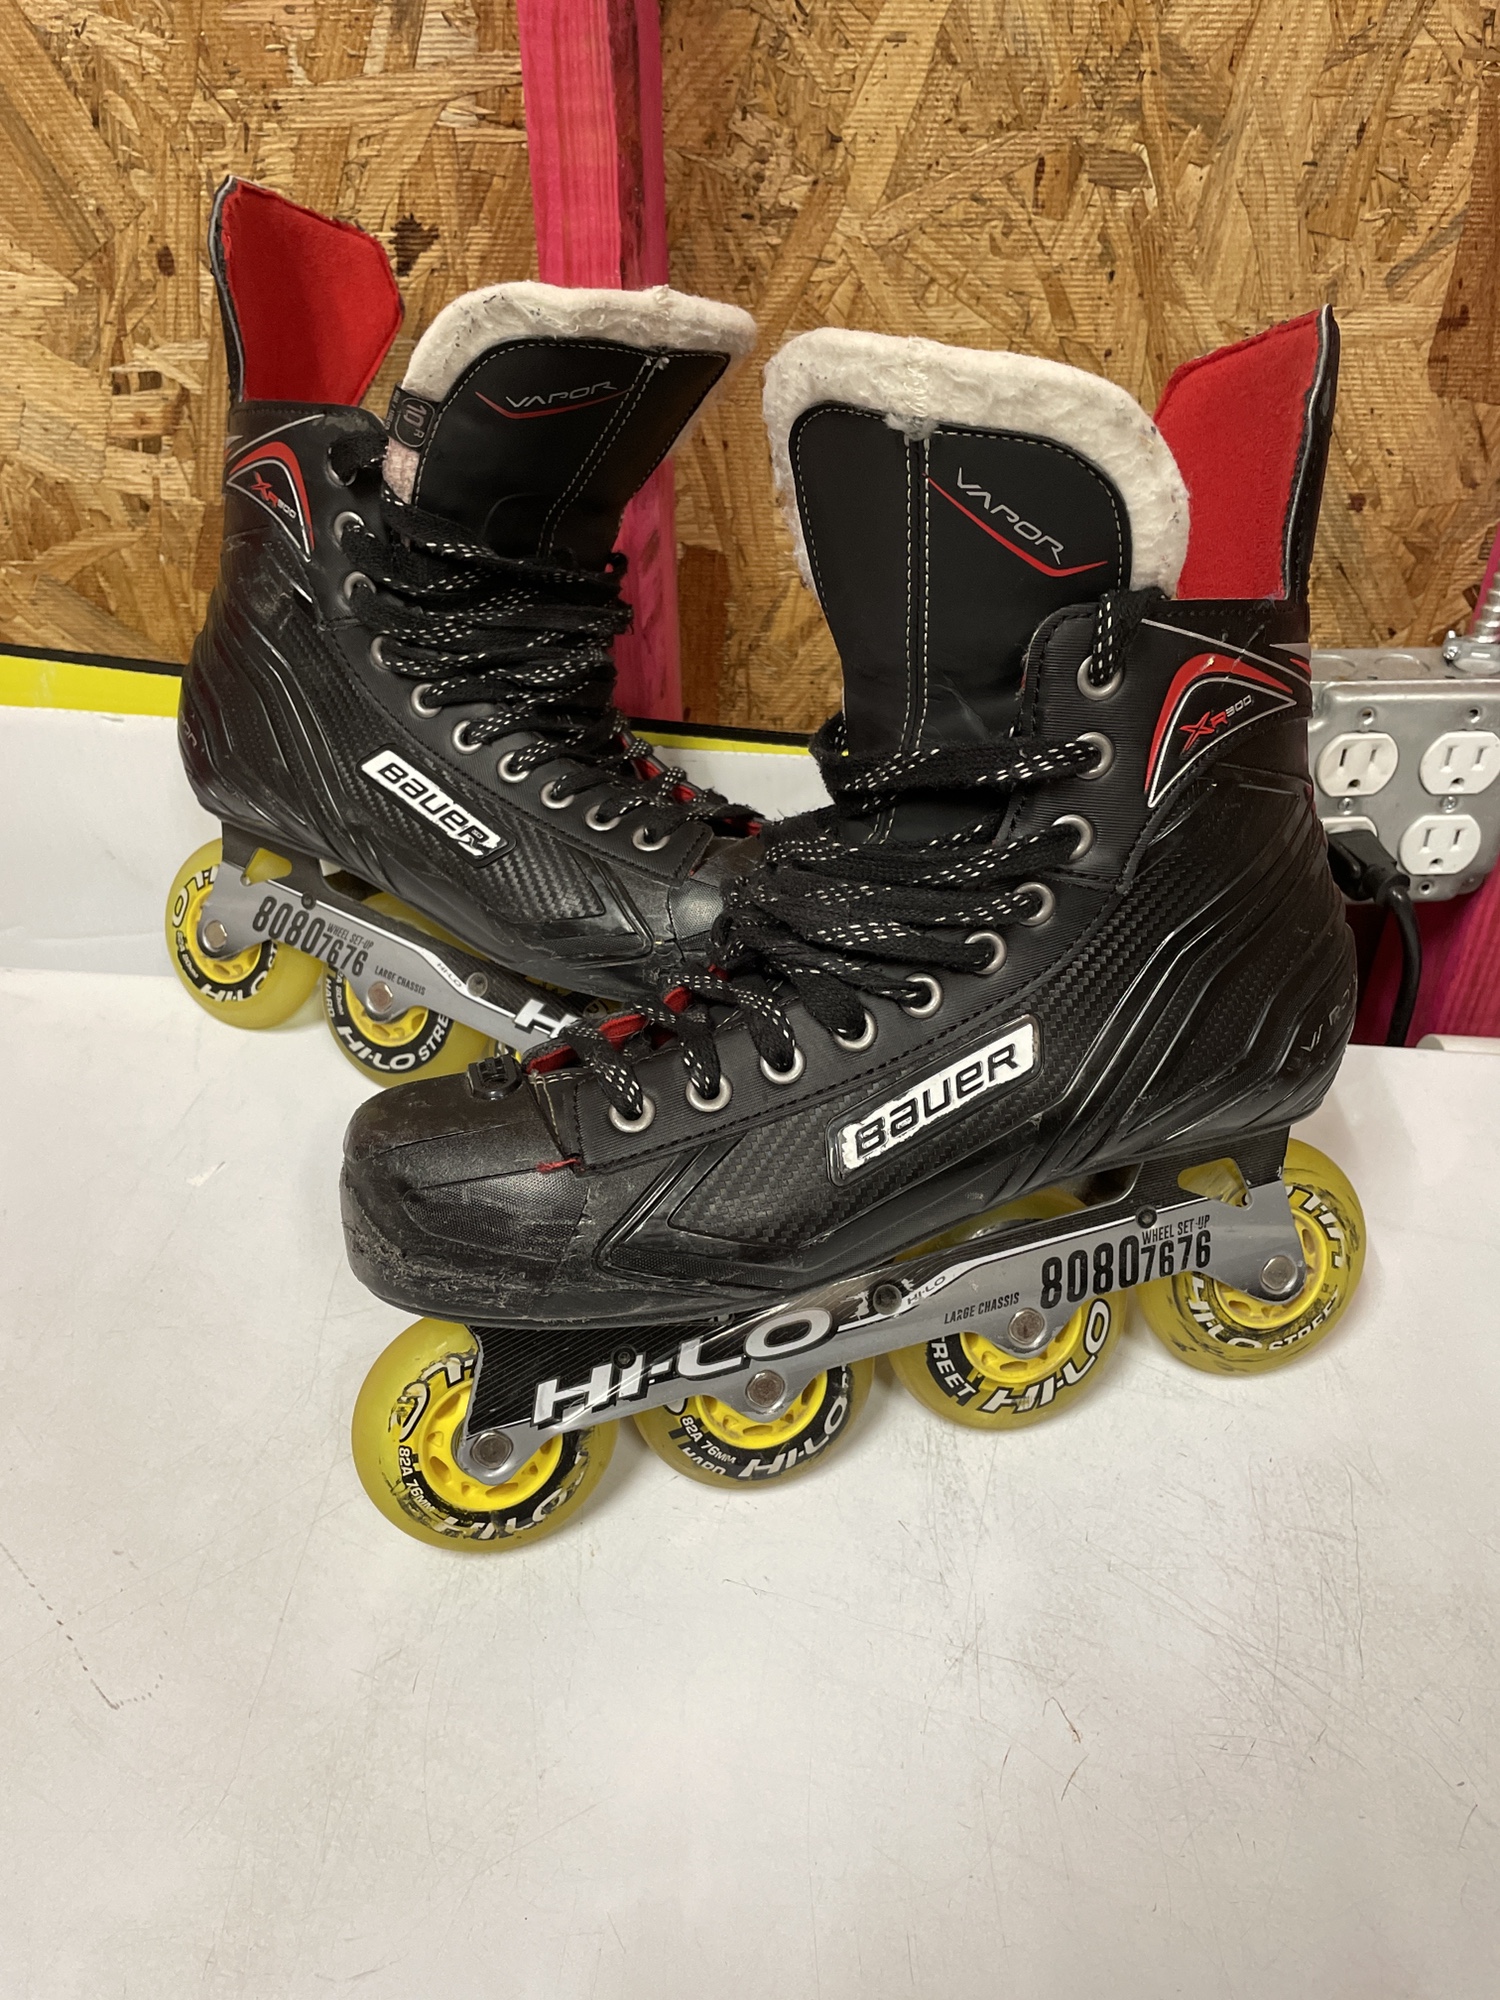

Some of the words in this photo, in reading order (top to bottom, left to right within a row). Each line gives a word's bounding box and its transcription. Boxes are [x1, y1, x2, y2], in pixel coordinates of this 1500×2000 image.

[505, 381, 617, 408] VAPOR
[957, 467, 1064, 565] VAPOR
[1179, 694, 1252, 752] XR300
[377, 762, 490, 849] BAUER
[327, 922, 349, 941] WHEEL
[349, 933, 375, 950] SET-UP
[375, 965, 396, 983] LARGE
[397, 975, 427, 996] CHASSIS
[437, 963, 462, 988] HI-LO
[337, 1025, 416, 1071] HI-LO
[418, 1013, 450, 1062] STRE
[856, 1043, 1020, 1160] BAUER
[1141, 1225, 1174, 1245] WHEEL
[1177, 1214, 1211, 1236] SET-UP
[907, 1276, 946, 1305] HI-LO
[944, 1306, 975, 1325] LARGE
[978, 1292, 1020, 1315] CHASSIS
[531, 1308, 834, 1427] HI-LO
[930, 1336, 977, 1398] REET
[980, 1299, 1111, 1413] HI-LO
[681, 1416, 704, 1443] 82A
[738, 1396, 848, 1478] HI-LO
[399, 1446, 414, 1477] 82A
